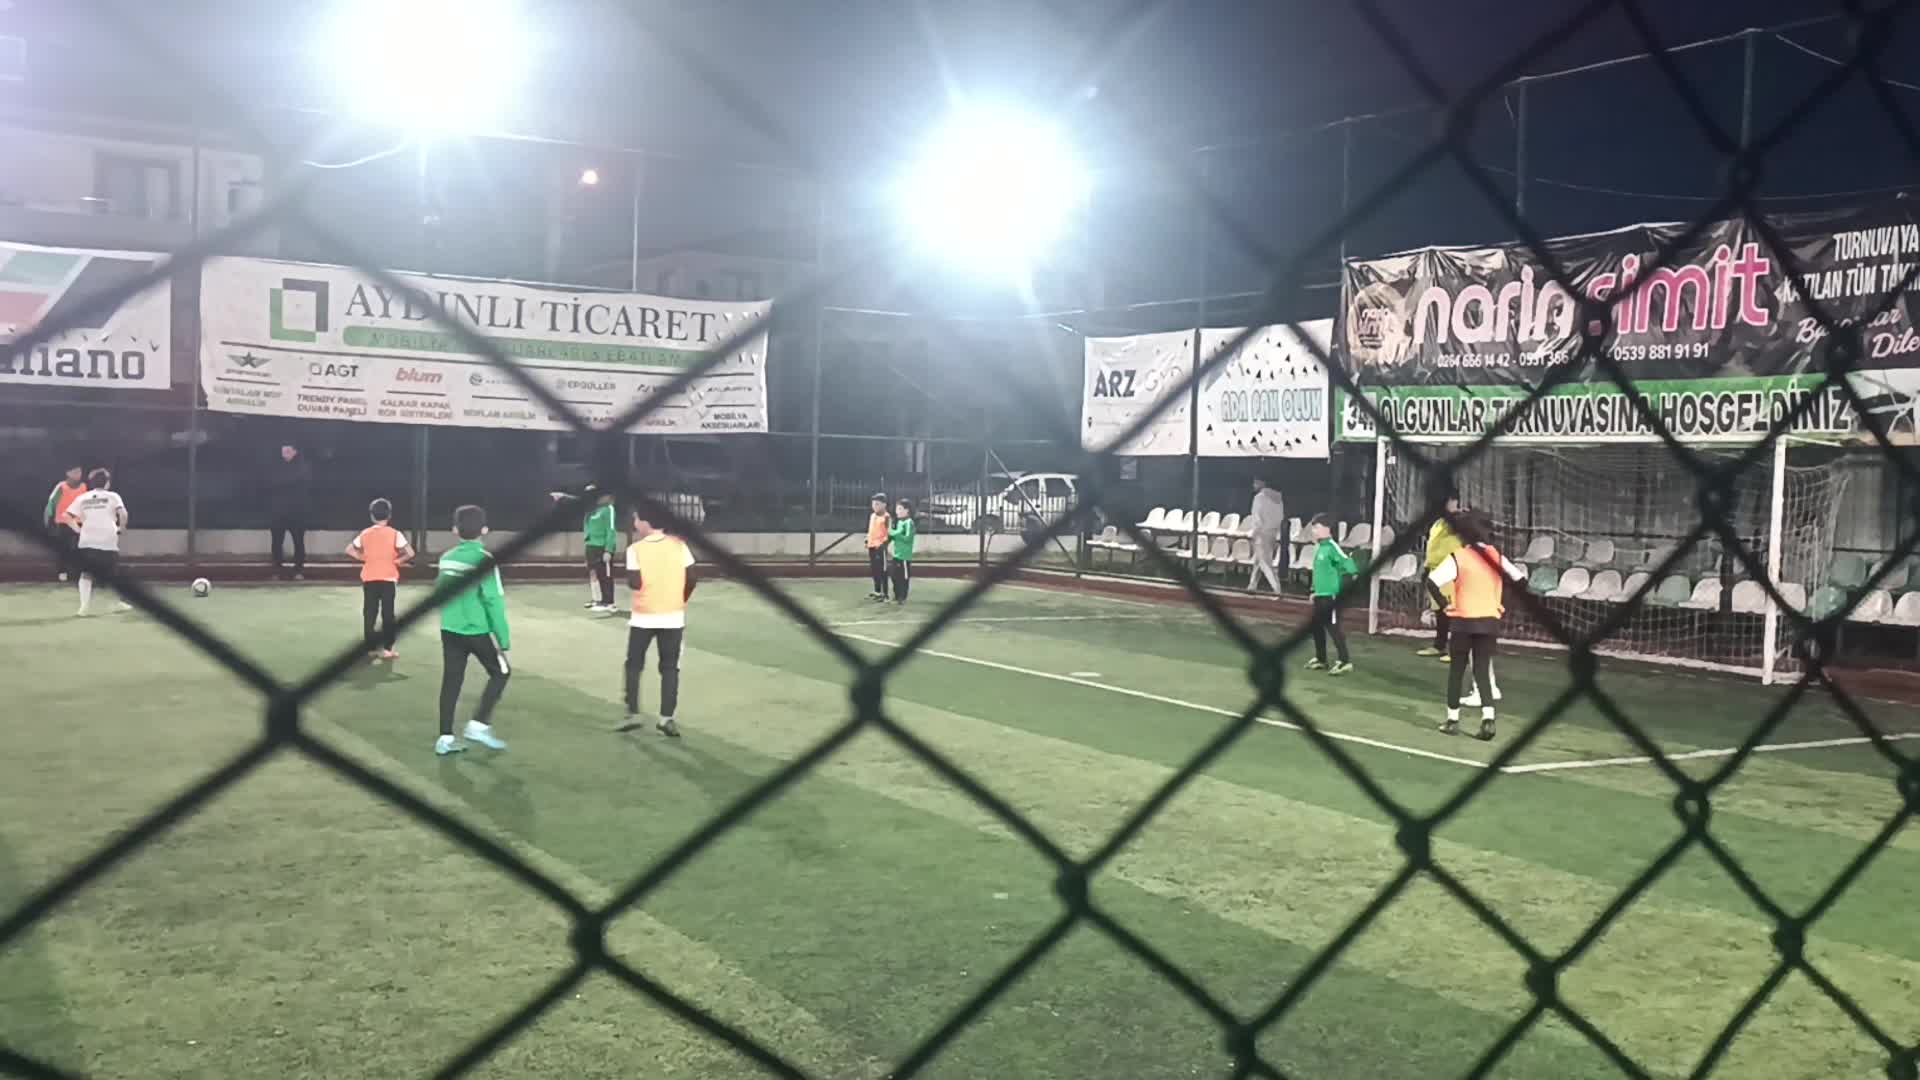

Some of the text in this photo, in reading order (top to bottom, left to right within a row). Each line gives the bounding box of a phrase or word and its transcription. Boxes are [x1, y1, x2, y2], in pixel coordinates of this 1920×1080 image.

[1846, 262, 1878, 297] TÜM
[343, 282, 716, 342] AYDINLI TİCARET
[1413, 264, 1576, 345] narin
[1613, 342, 1709, 361] 0539 881 91 91
[324, 363, 360, 378] AGT
[395, 367, 444, 384] blum
[1093, 369, 1137, 398] ARZ
[1381, 396, 1484, 434] OLGUNLAR
